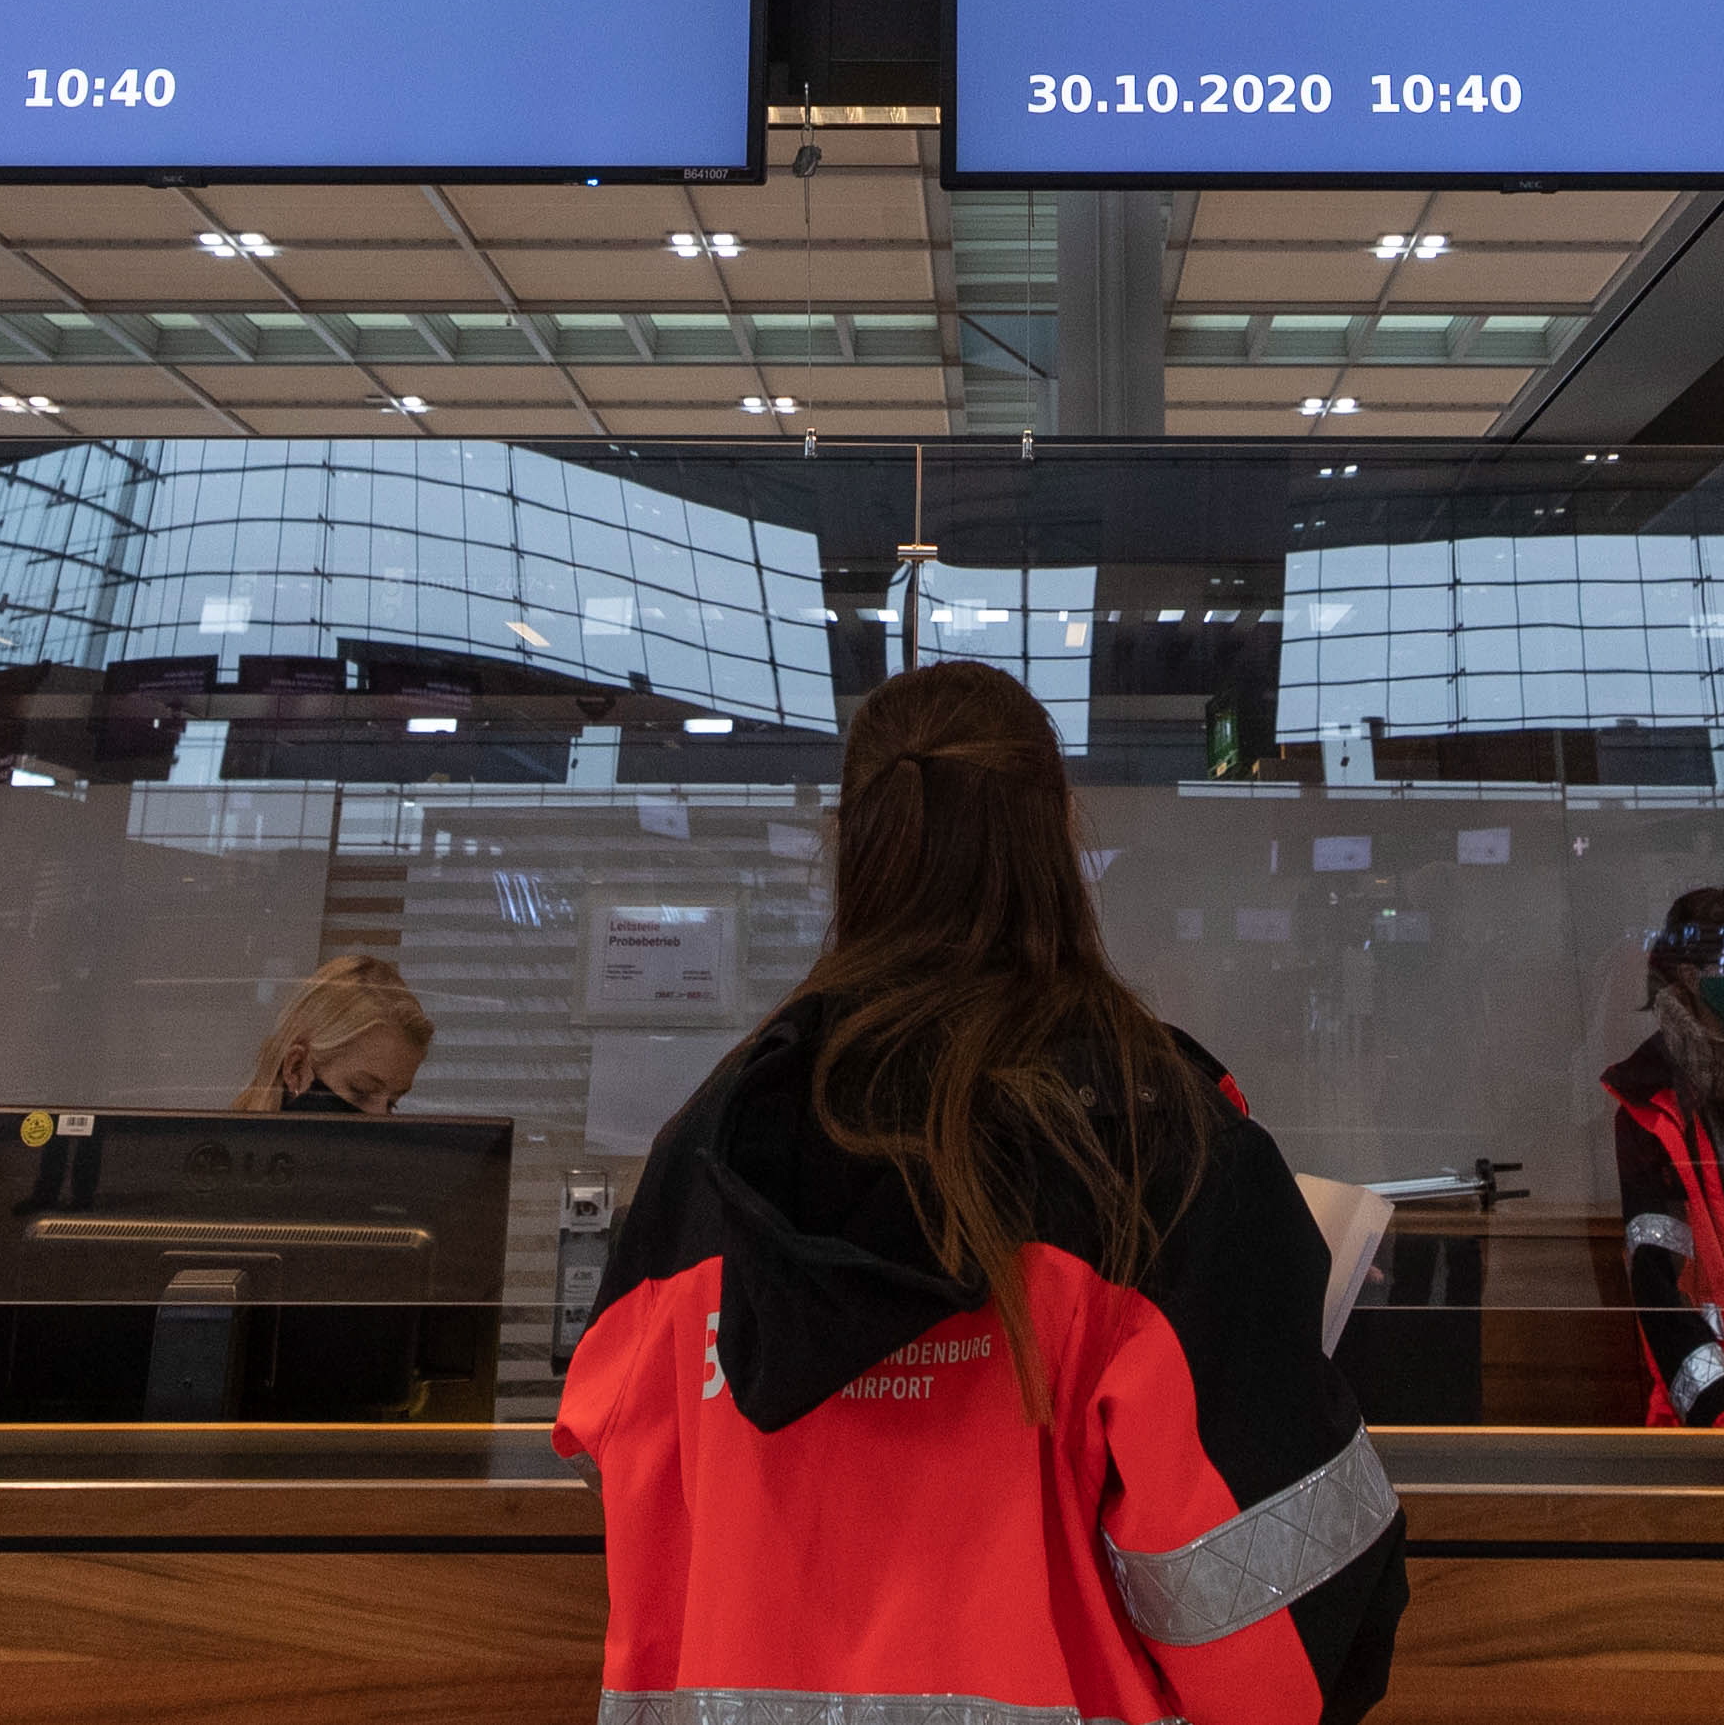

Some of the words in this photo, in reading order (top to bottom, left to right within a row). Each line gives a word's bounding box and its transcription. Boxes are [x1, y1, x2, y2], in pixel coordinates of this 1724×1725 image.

[25, 68, 176, 108] 10:40
[1027, 74, 1332, 114] 30.10.2020
[1371, 74, 1522, 114] 10:40
[683, 168, 729, 180] B641007
[608, 935, 682, 948] Probebetrieb
[883, 1334, 993, 1366] NDENBURG
[840, 1374, 936, 1401] AIRPORT
